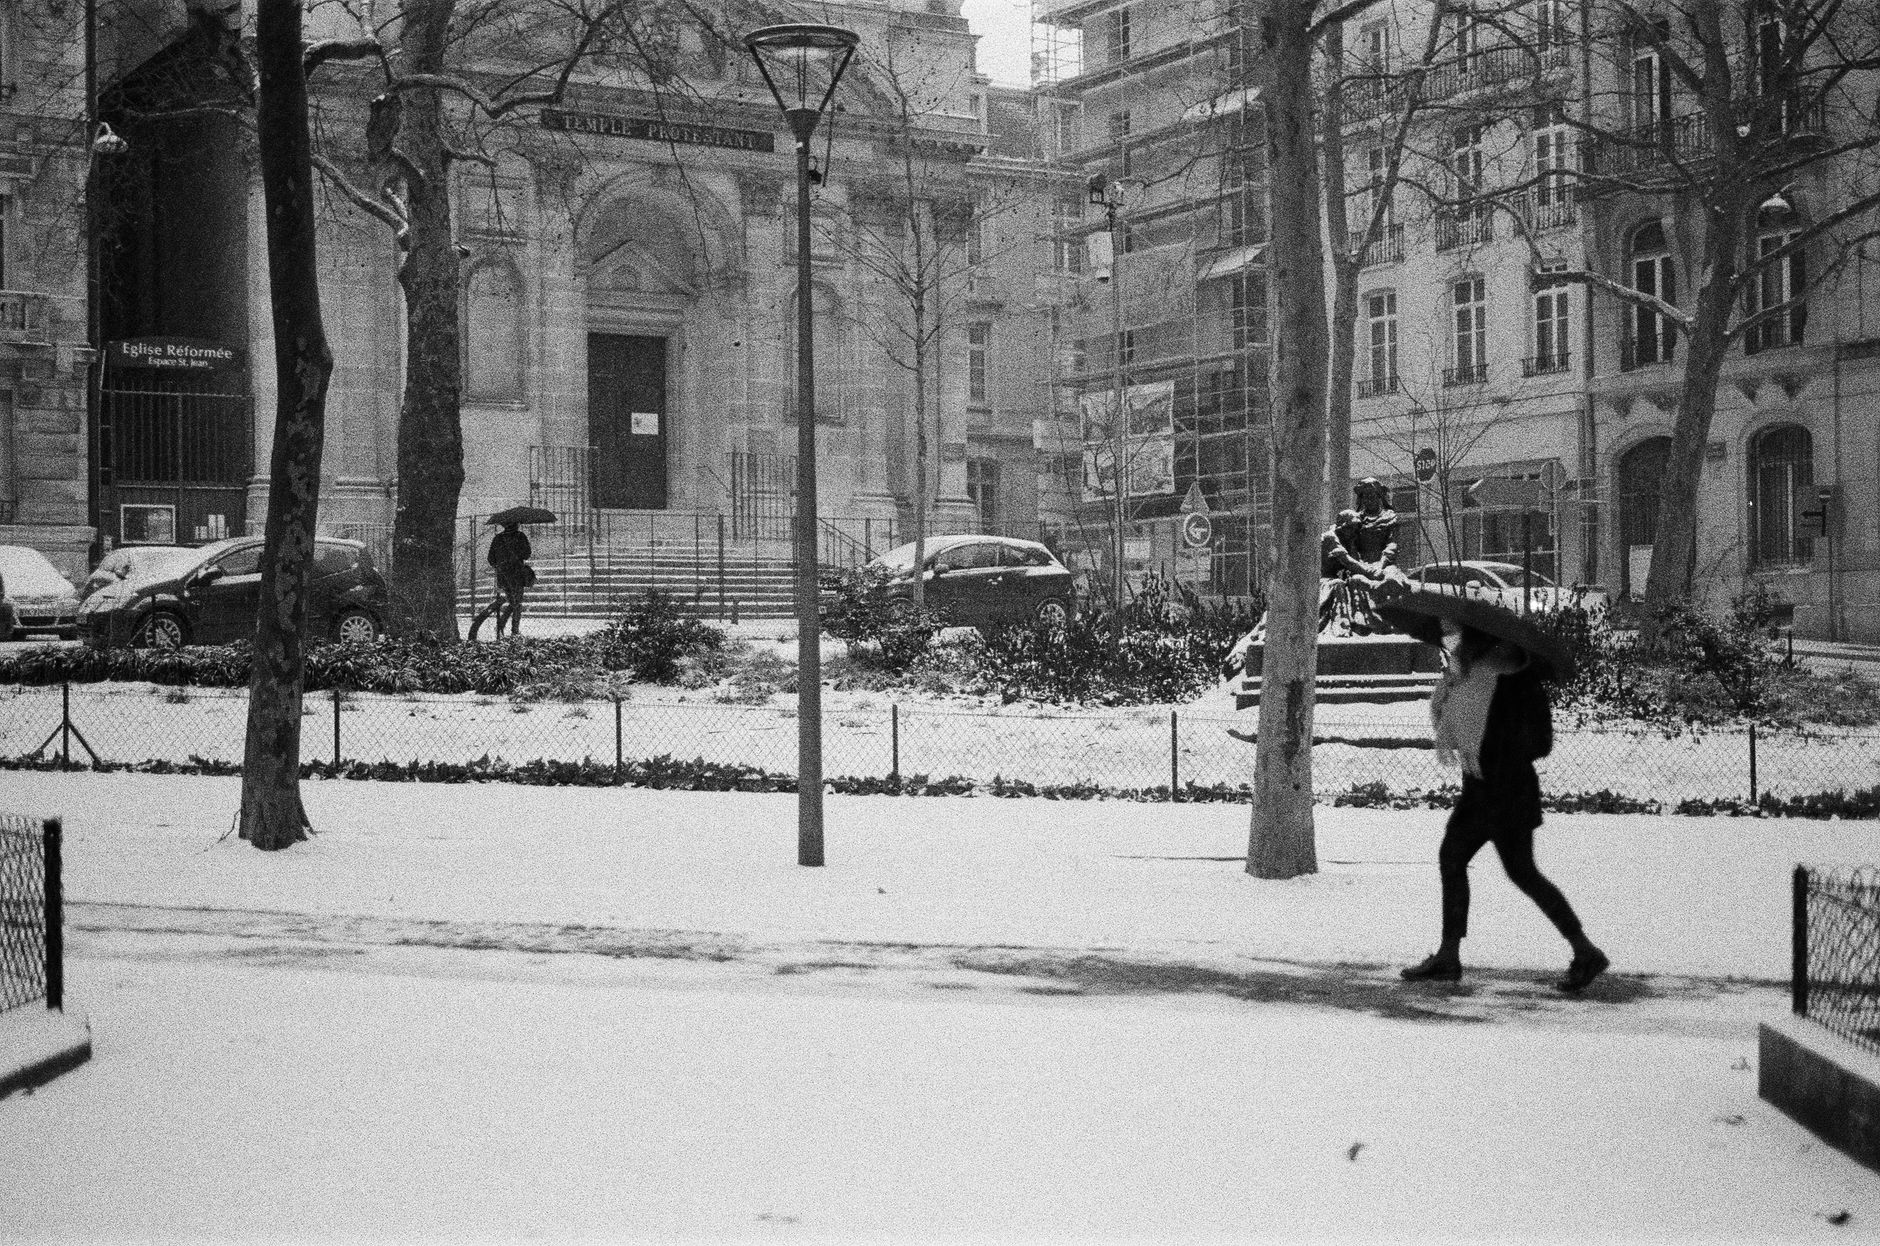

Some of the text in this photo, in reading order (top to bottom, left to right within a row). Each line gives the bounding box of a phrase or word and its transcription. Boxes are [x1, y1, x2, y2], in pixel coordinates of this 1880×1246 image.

[562, 115, 756, 149] TEMPLE PROTESTANT
[122, 342, 233, 359] Eglise Réformée
[1416, 459, 1436, 470] STOP
